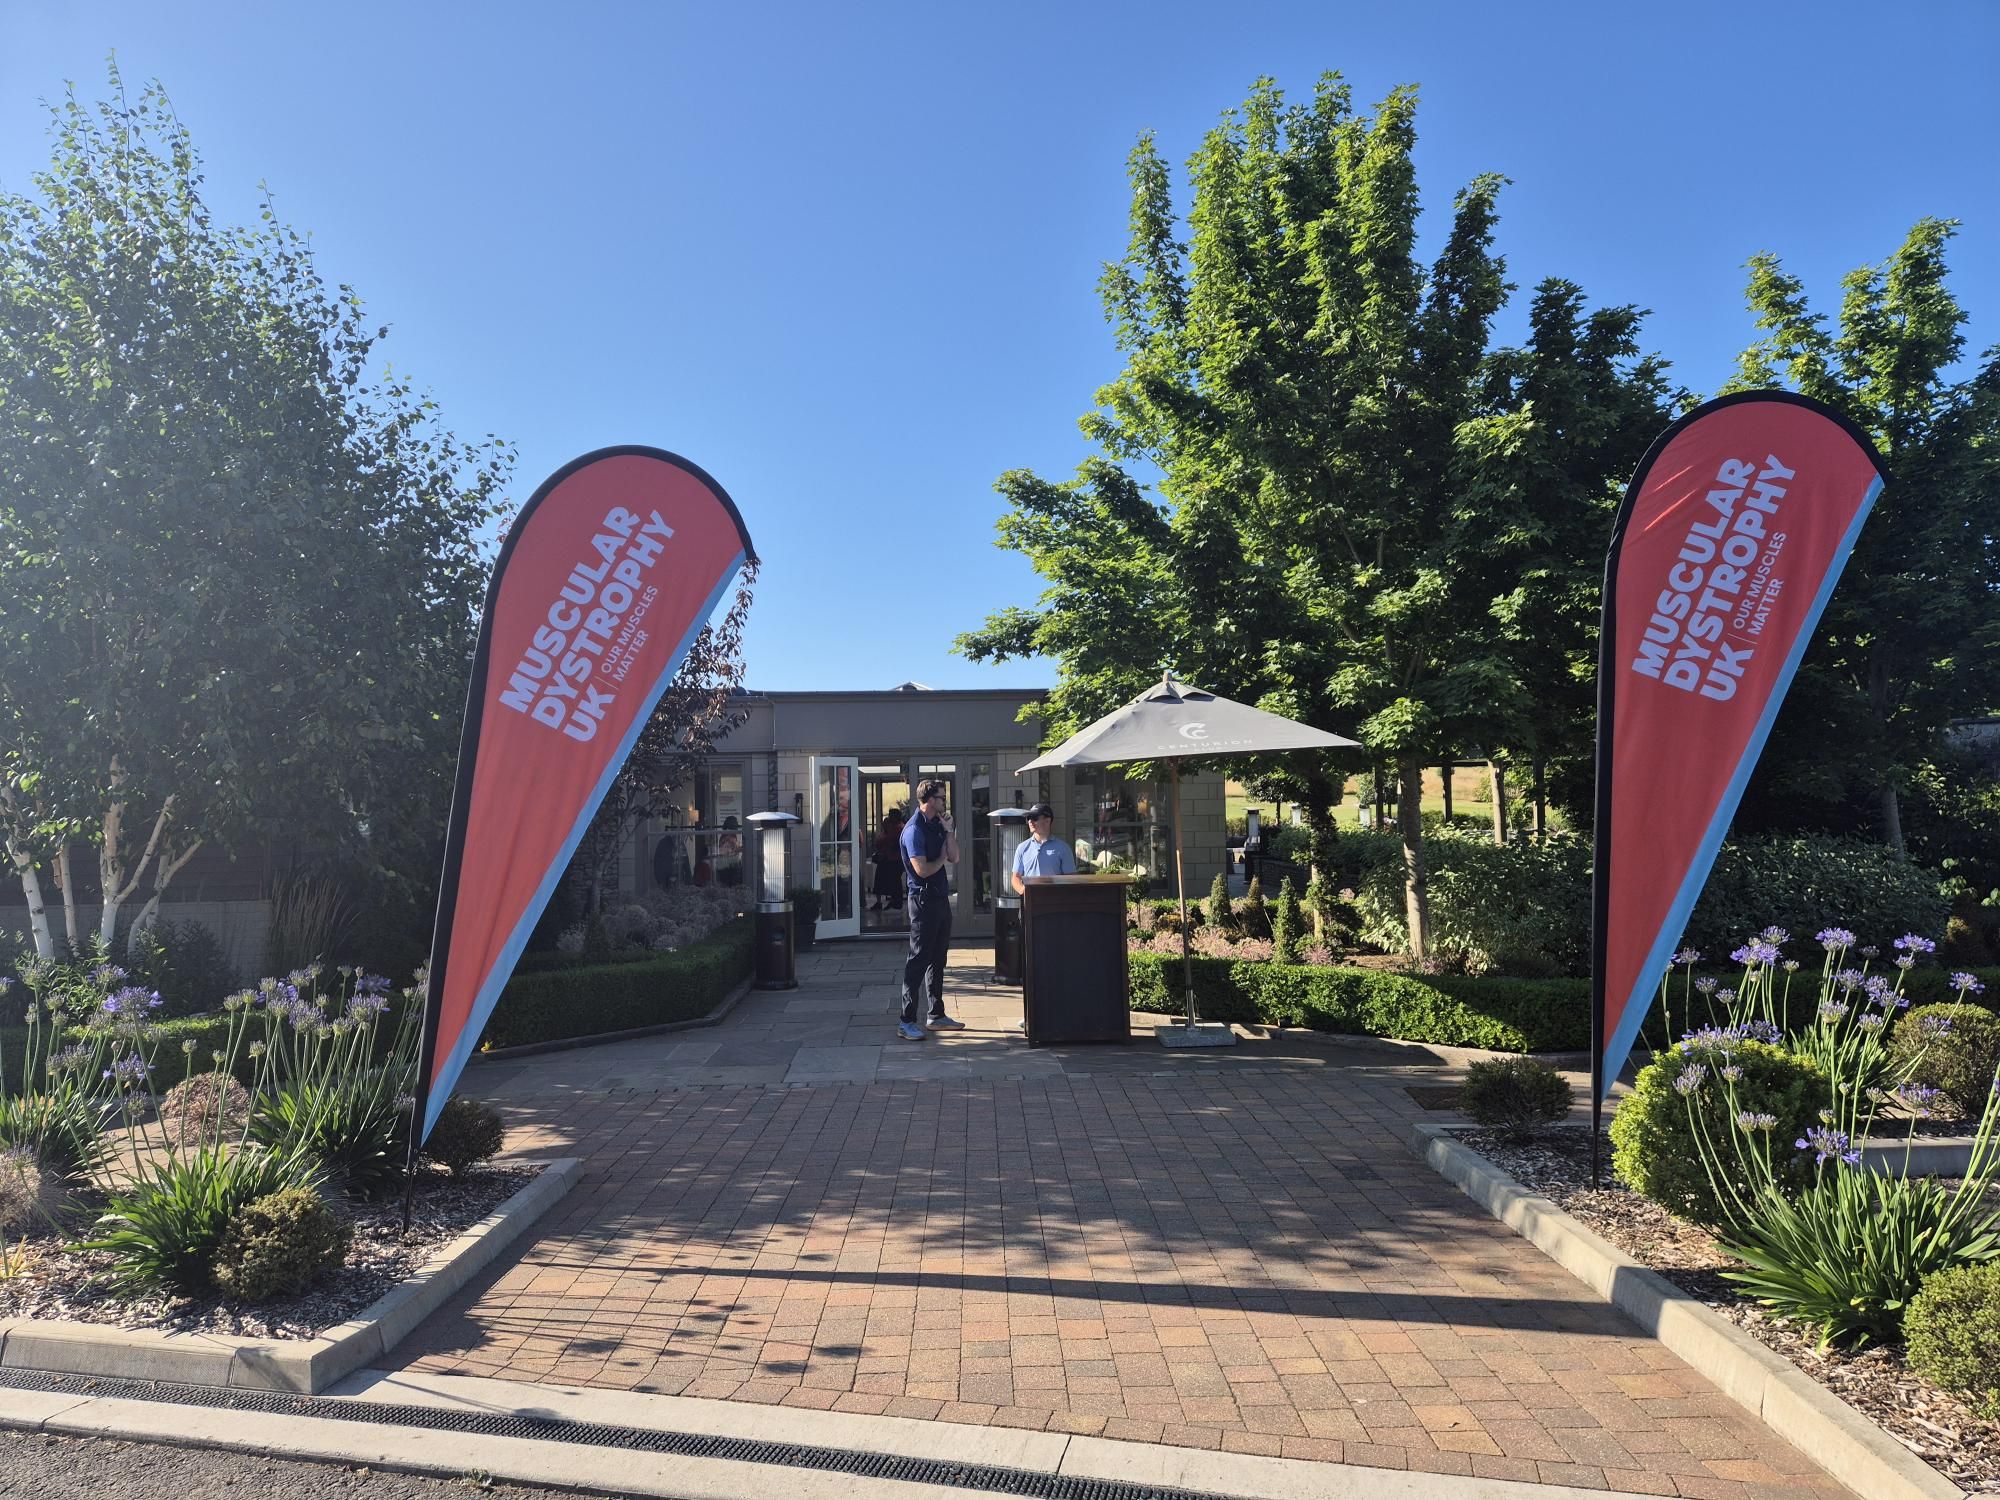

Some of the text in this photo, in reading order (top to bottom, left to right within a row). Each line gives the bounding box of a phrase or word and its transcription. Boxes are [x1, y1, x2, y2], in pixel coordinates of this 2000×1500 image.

[498, 506, 641, 713] MUSCULAR
[1631, 458, 1755, 679] MUSCULAR
[1663, 454, 1796, 693] DYSTROPHY
[1733, 531, 1787, 630] OUR MUSCLES
[1747, 578, 1784, 636] MATTER
[530, 509, 676, 729] DYSTROPHY
[600, 585, 658, 674] OUR MUSCLES
[612, 630, 649, 682] MATTER
[562, 690, 616, 742] UK
[1699, 643, 1754, 701] UK
